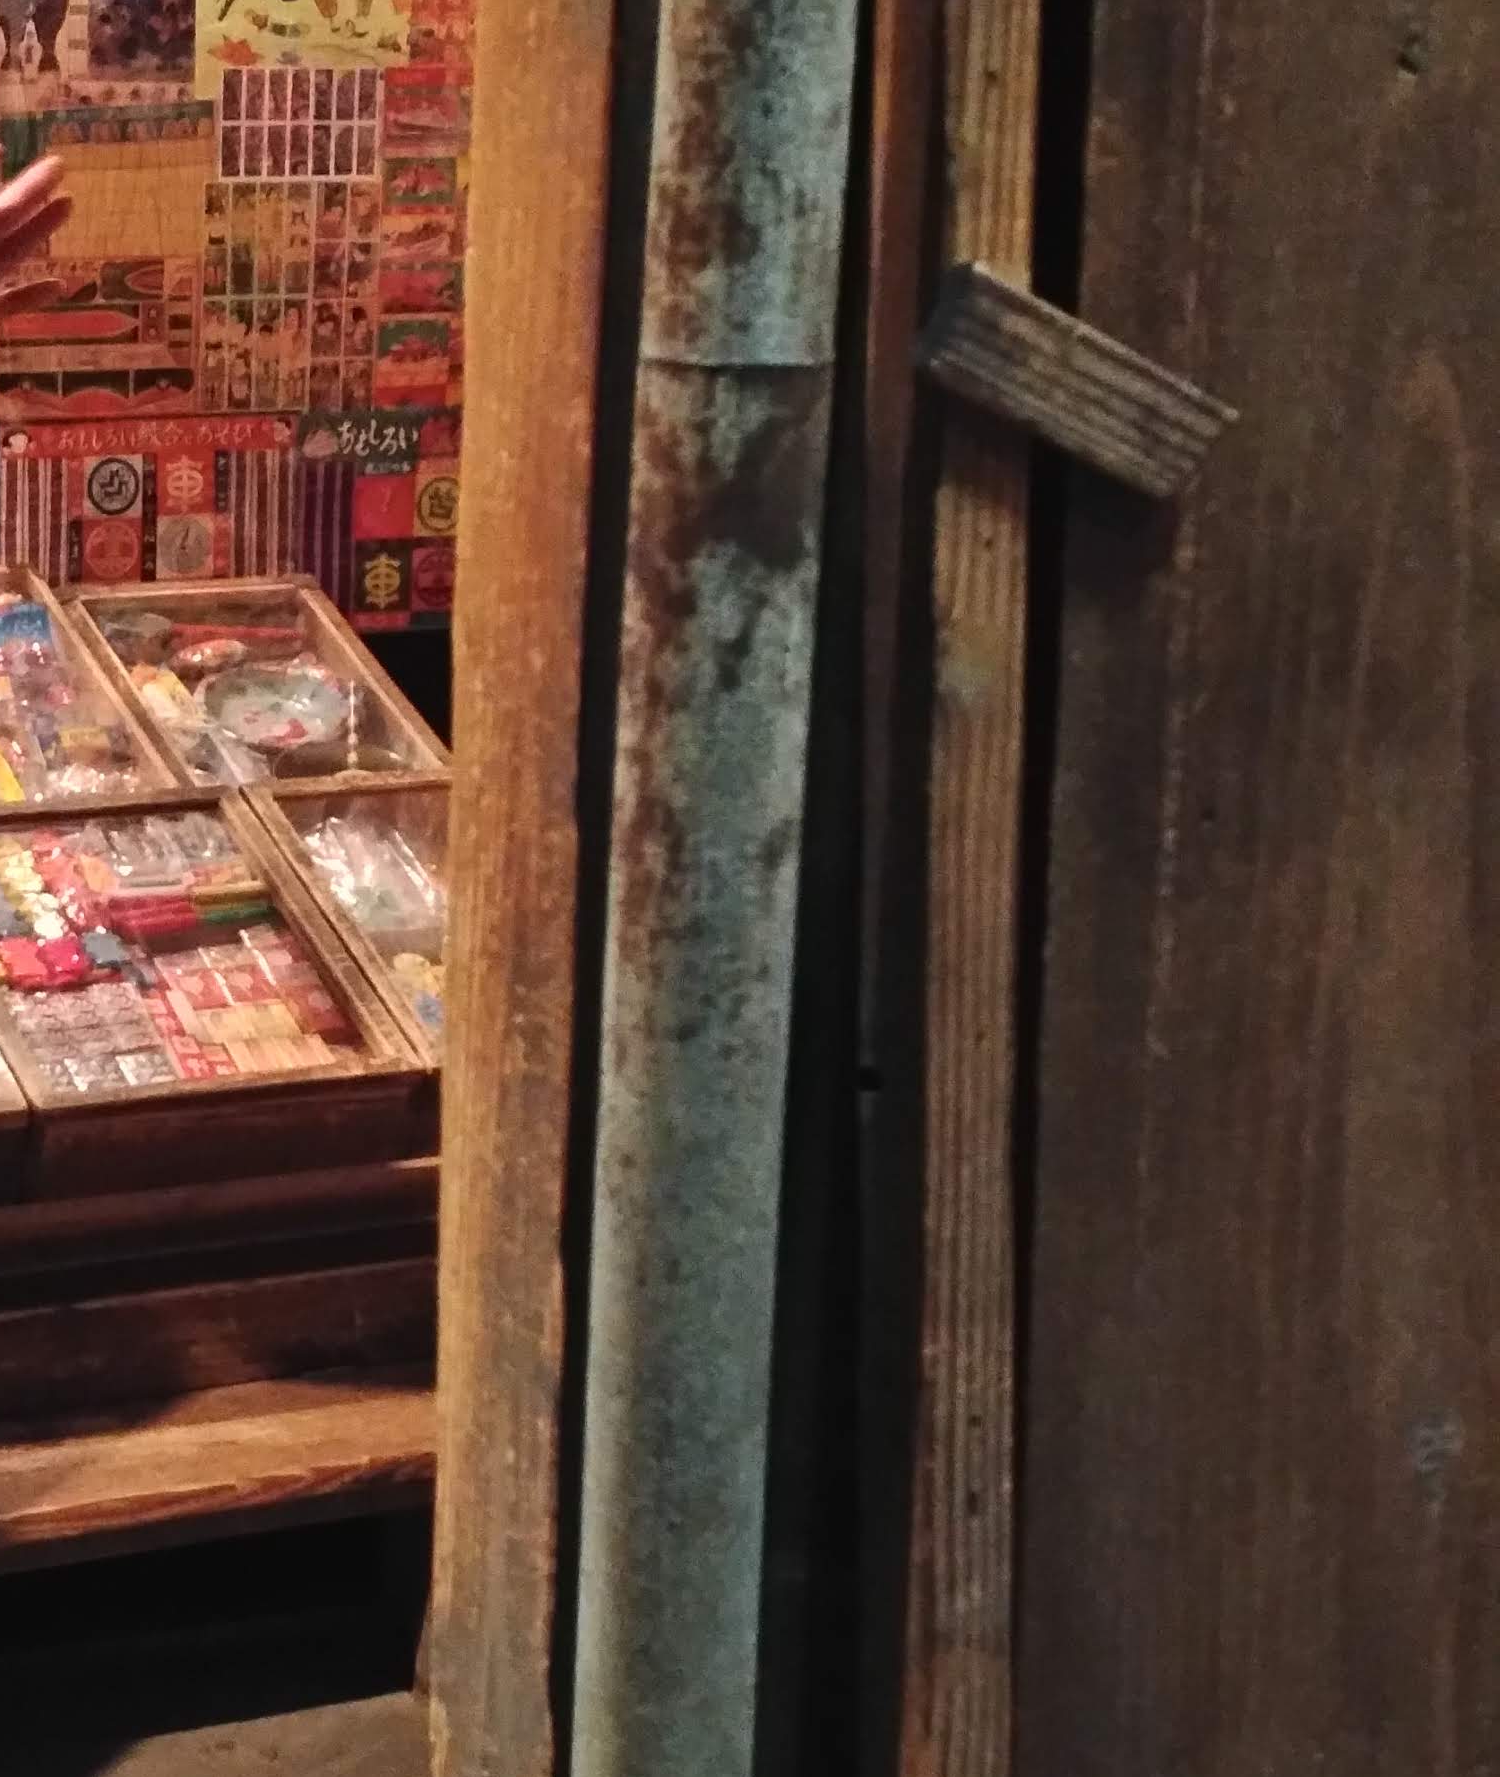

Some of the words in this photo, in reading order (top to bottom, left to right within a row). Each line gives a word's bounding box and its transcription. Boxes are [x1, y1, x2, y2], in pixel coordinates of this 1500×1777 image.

[337, 419, 420, 457] おもしろい
